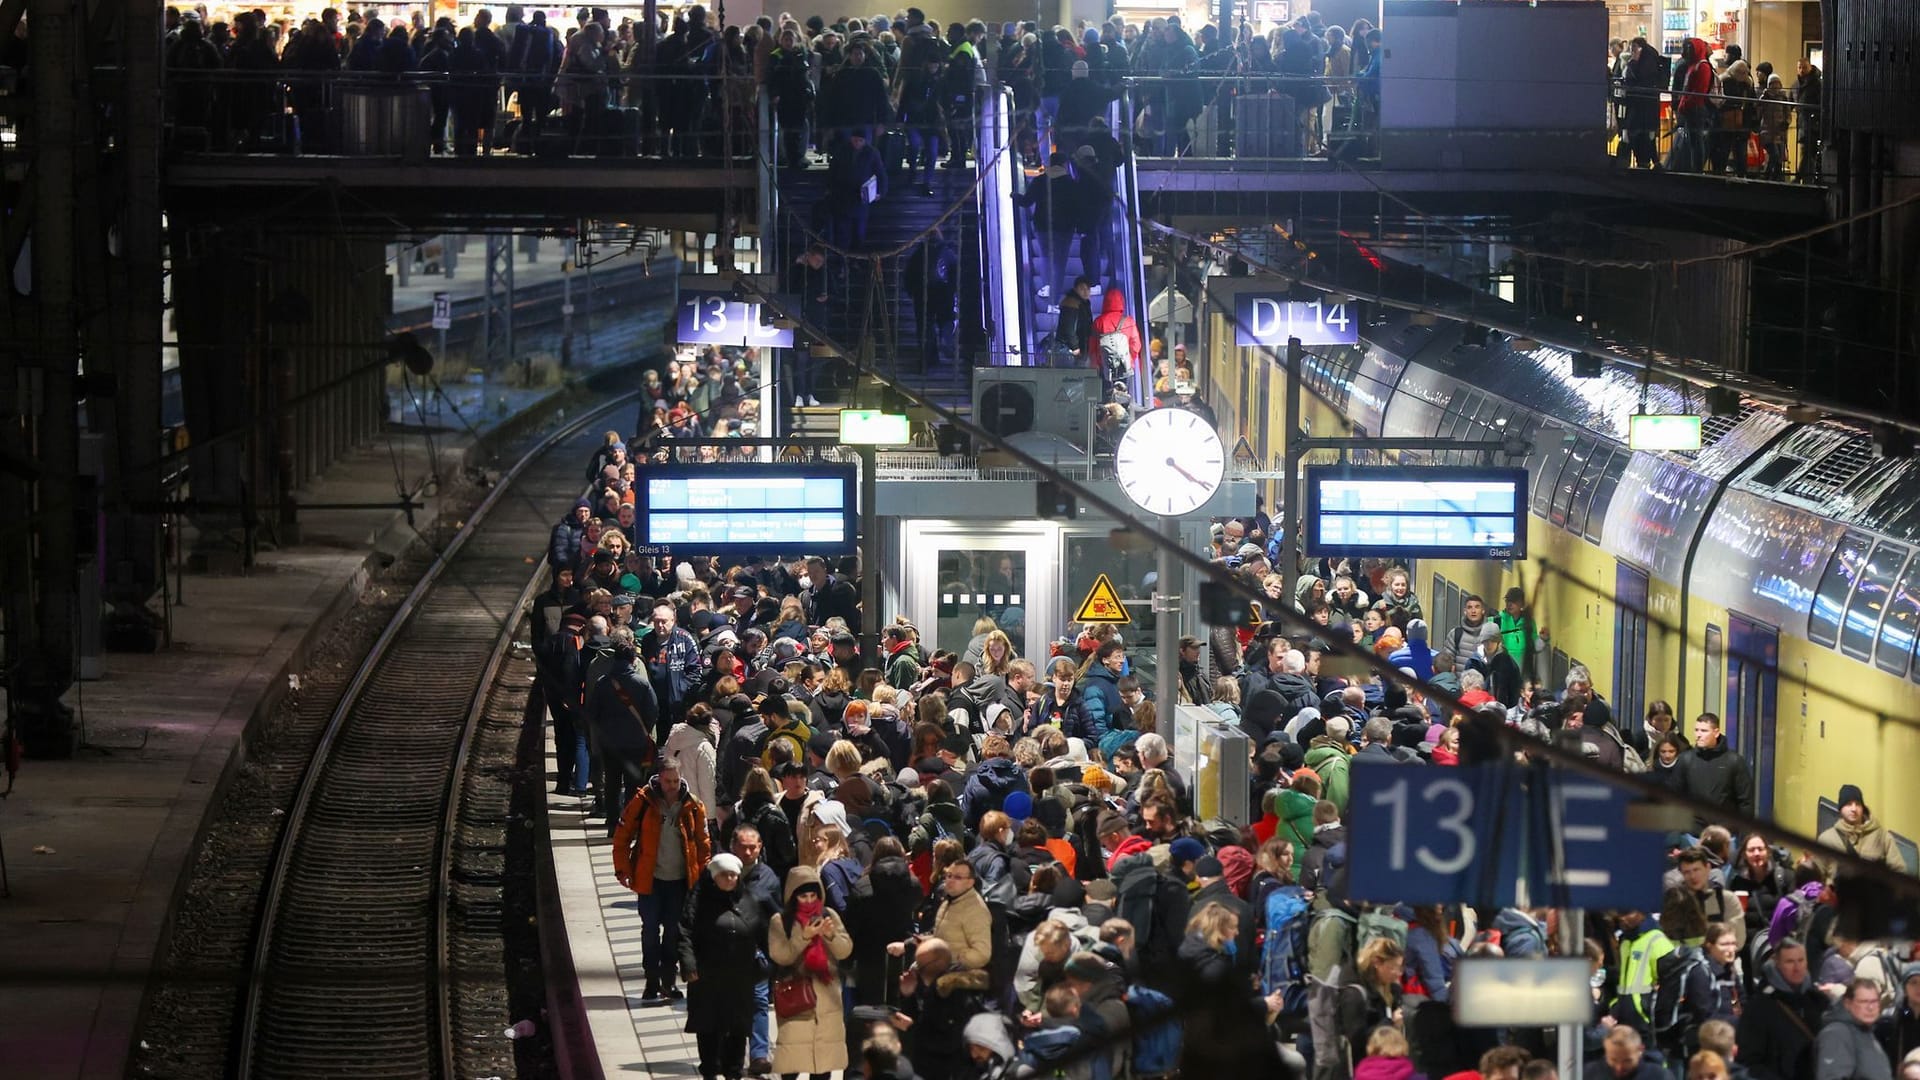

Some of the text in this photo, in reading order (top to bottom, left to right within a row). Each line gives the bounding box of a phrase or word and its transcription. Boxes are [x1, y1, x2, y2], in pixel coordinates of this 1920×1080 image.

[686, 296, 727, 333] 13
[1252, 298, 1350, 336] D 14
[639, 545, 670, 554] Gleis 13
[1490, 548, 1511, 557] Gleis
[1372, 778, 1612, 886] 13 E
